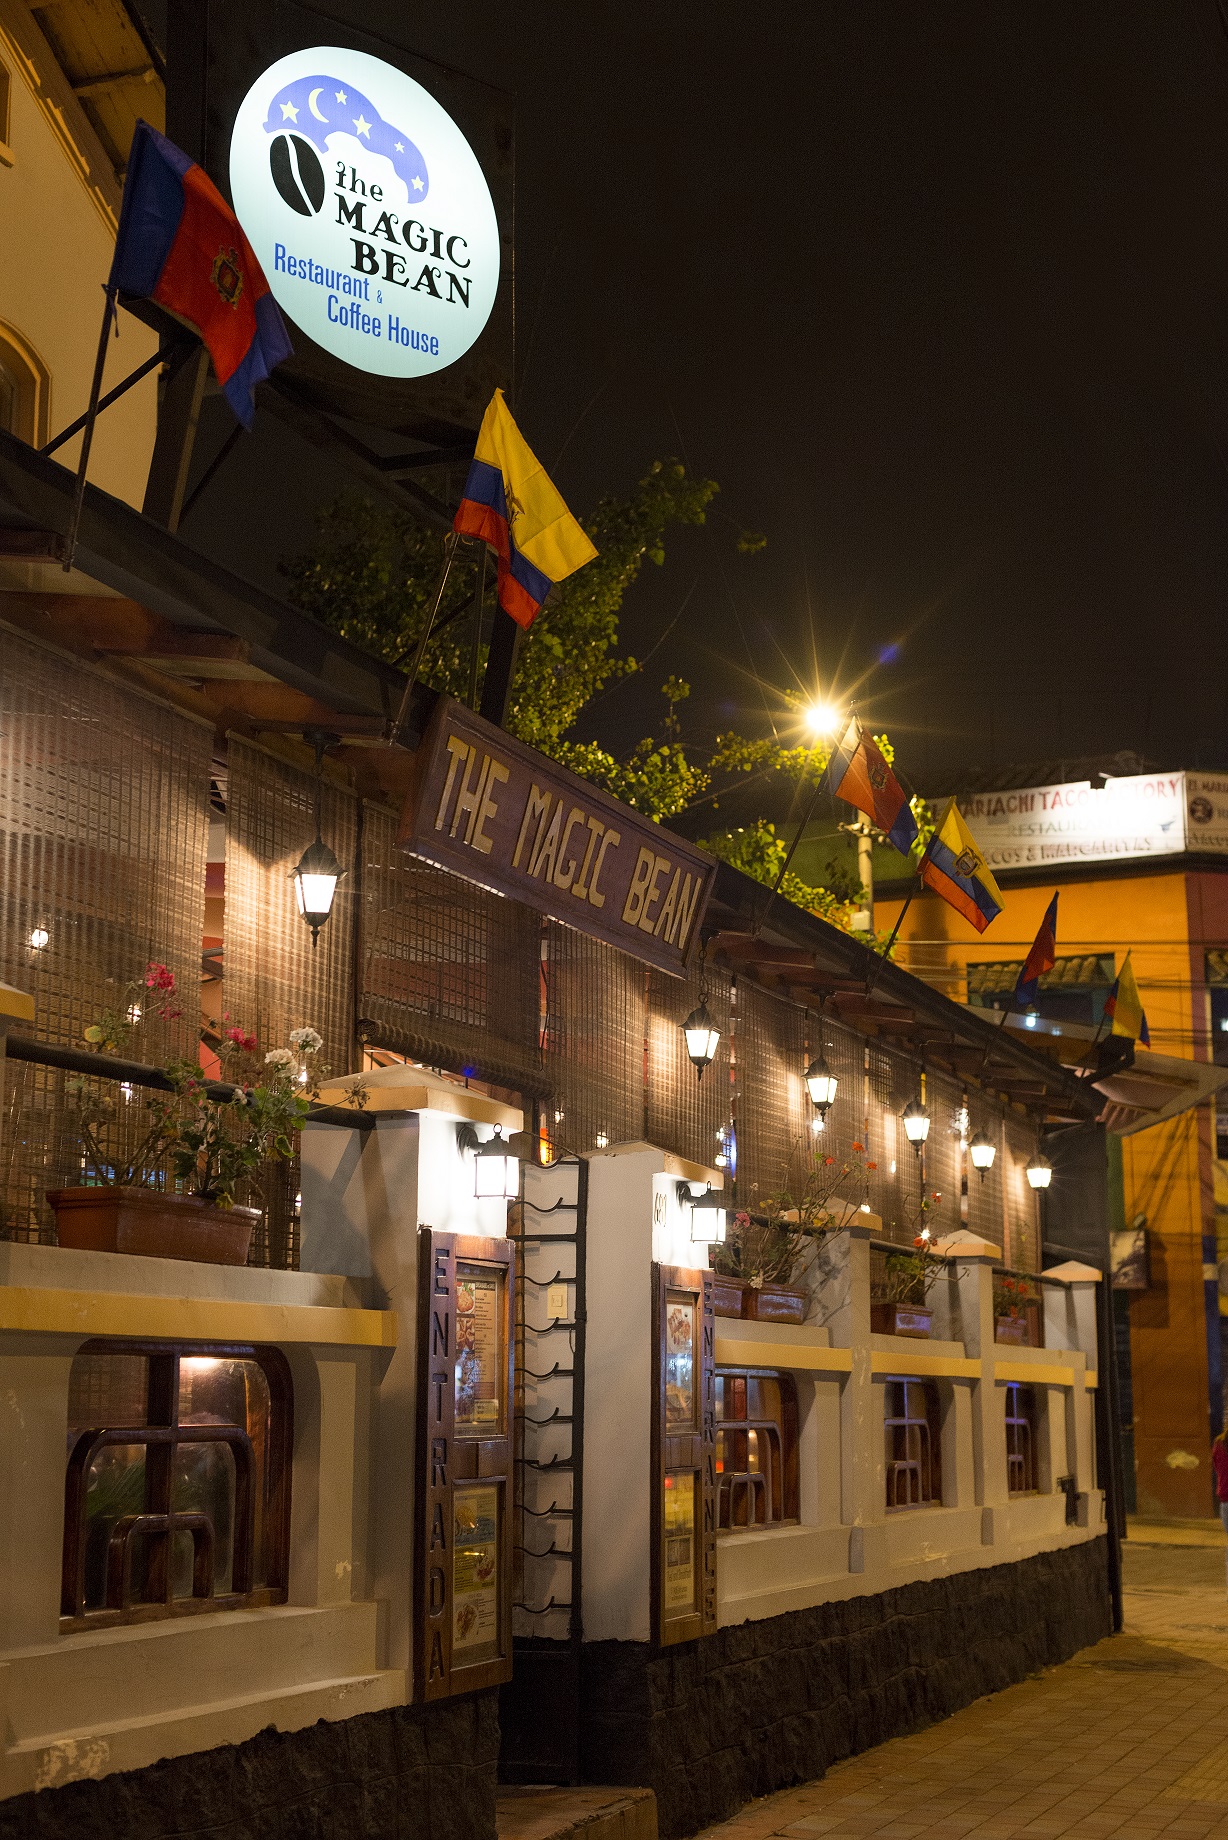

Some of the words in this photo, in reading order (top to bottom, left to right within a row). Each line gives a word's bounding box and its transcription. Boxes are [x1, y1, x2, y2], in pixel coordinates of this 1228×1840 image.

[335, 161, 384, 202] the
[334, 192, 472, 269] MAGIC
[274, 243, 370, 302] Restaurant
[376, 289, 383, 304] &
[350, 237, 473, 309] BEAN
[327, 295, 381, 338] Coffee
[388, 314, 440, 356] House
[961, 793, 1036, 820] ARIACHI
[1039, 790, 1089, 811] TACO
[434, 734, 510, 855] THE
[512, 783, 622, 908] MAGIC
[622, 846, 703, 950] BEAN
[428, 1247, 450, 1682] ENTRADA
[703, 1281, 715, 1624] ENTRANCE
